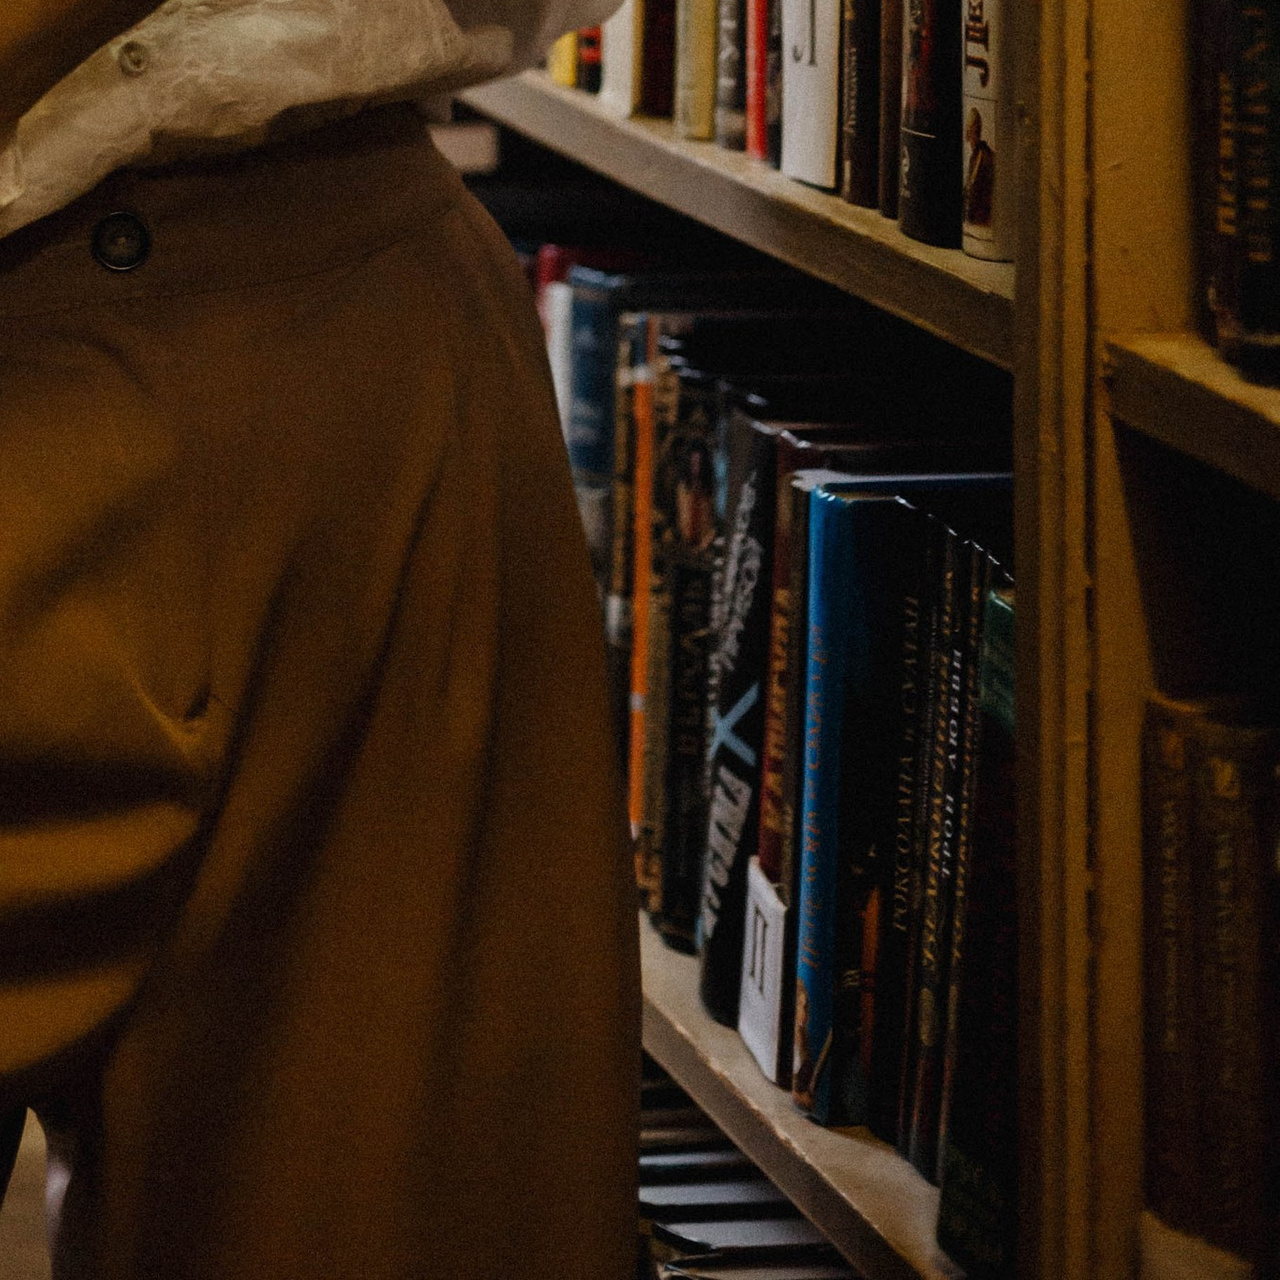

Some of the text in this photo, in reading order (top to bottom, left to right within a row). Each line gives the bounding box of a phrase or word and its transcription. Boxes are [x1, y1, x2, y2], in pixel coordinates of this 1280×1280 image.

[902, 594, 919, 714] СУЛТАН
[941, 648, 962, 877] ТРОН ЛЮБВИ
[892, 755, 914, 932] РОКСОЛАНА
[749, 906, 769, 993] П
